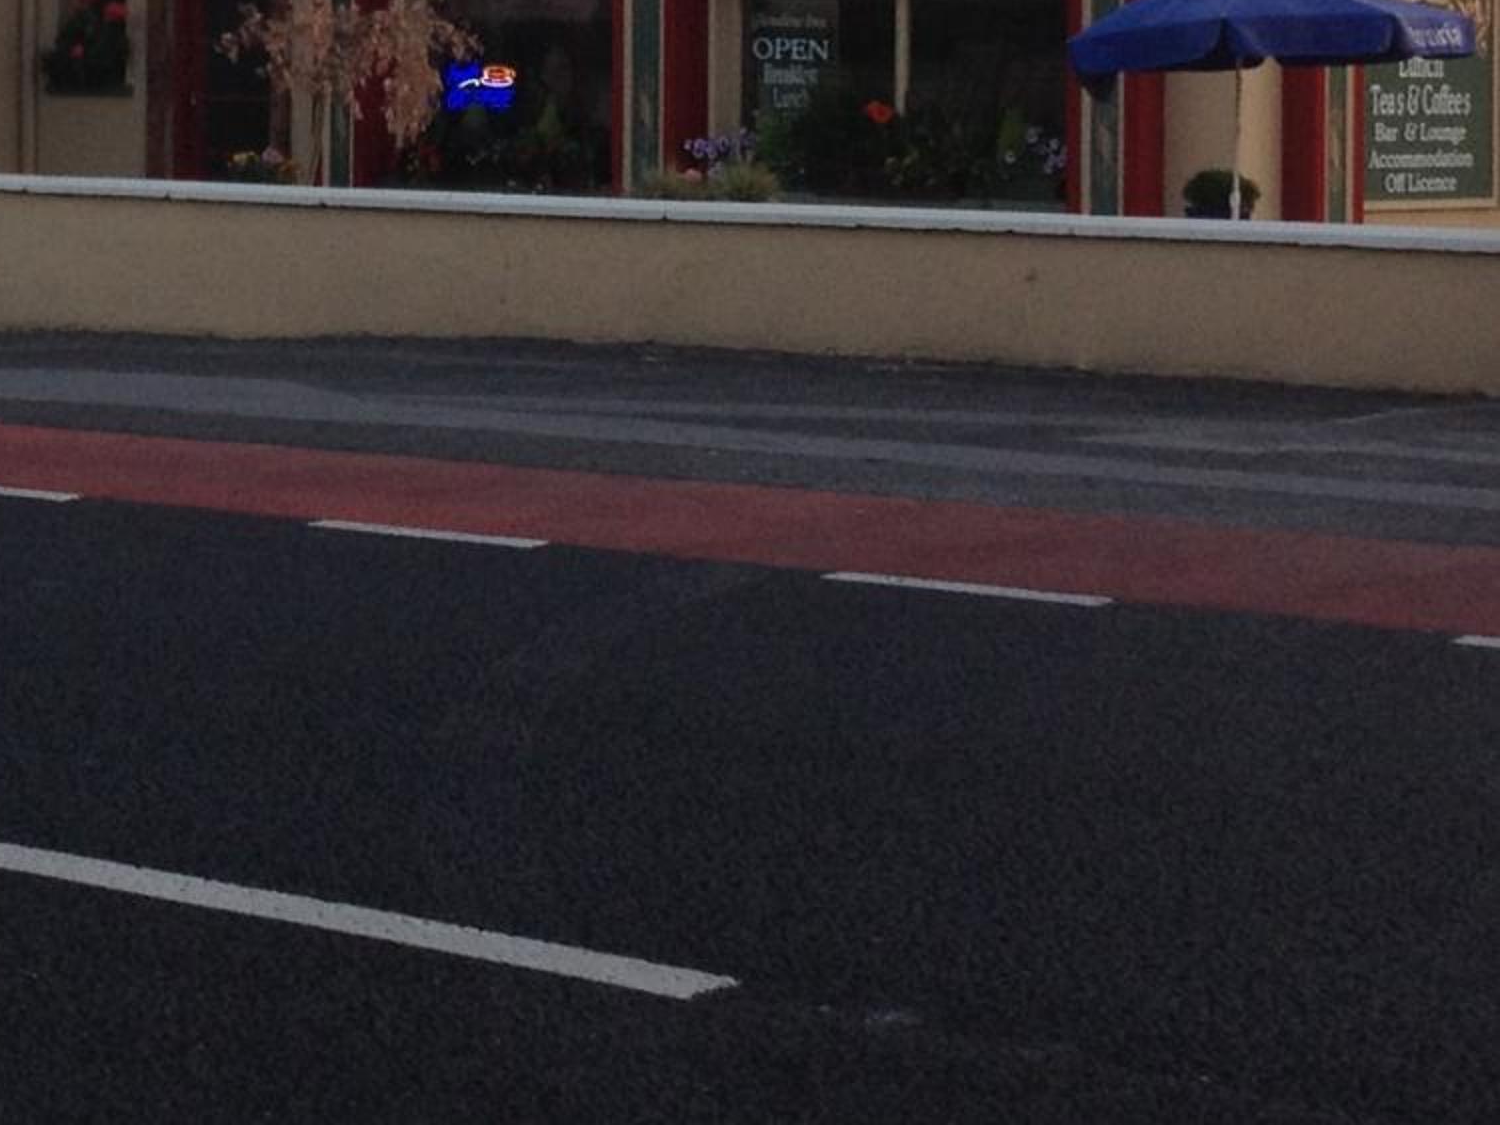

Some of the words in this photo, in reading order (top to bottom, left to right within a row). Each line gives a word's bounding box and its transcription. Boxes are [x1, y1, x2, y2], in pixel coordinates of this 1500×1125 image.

[753, 37, 830, 60] OPEN
[1375, 122, 1398, 143] Bar
[1404, 122, 1419, 142] &
[1420, 122, 1467, 146] Lounge
